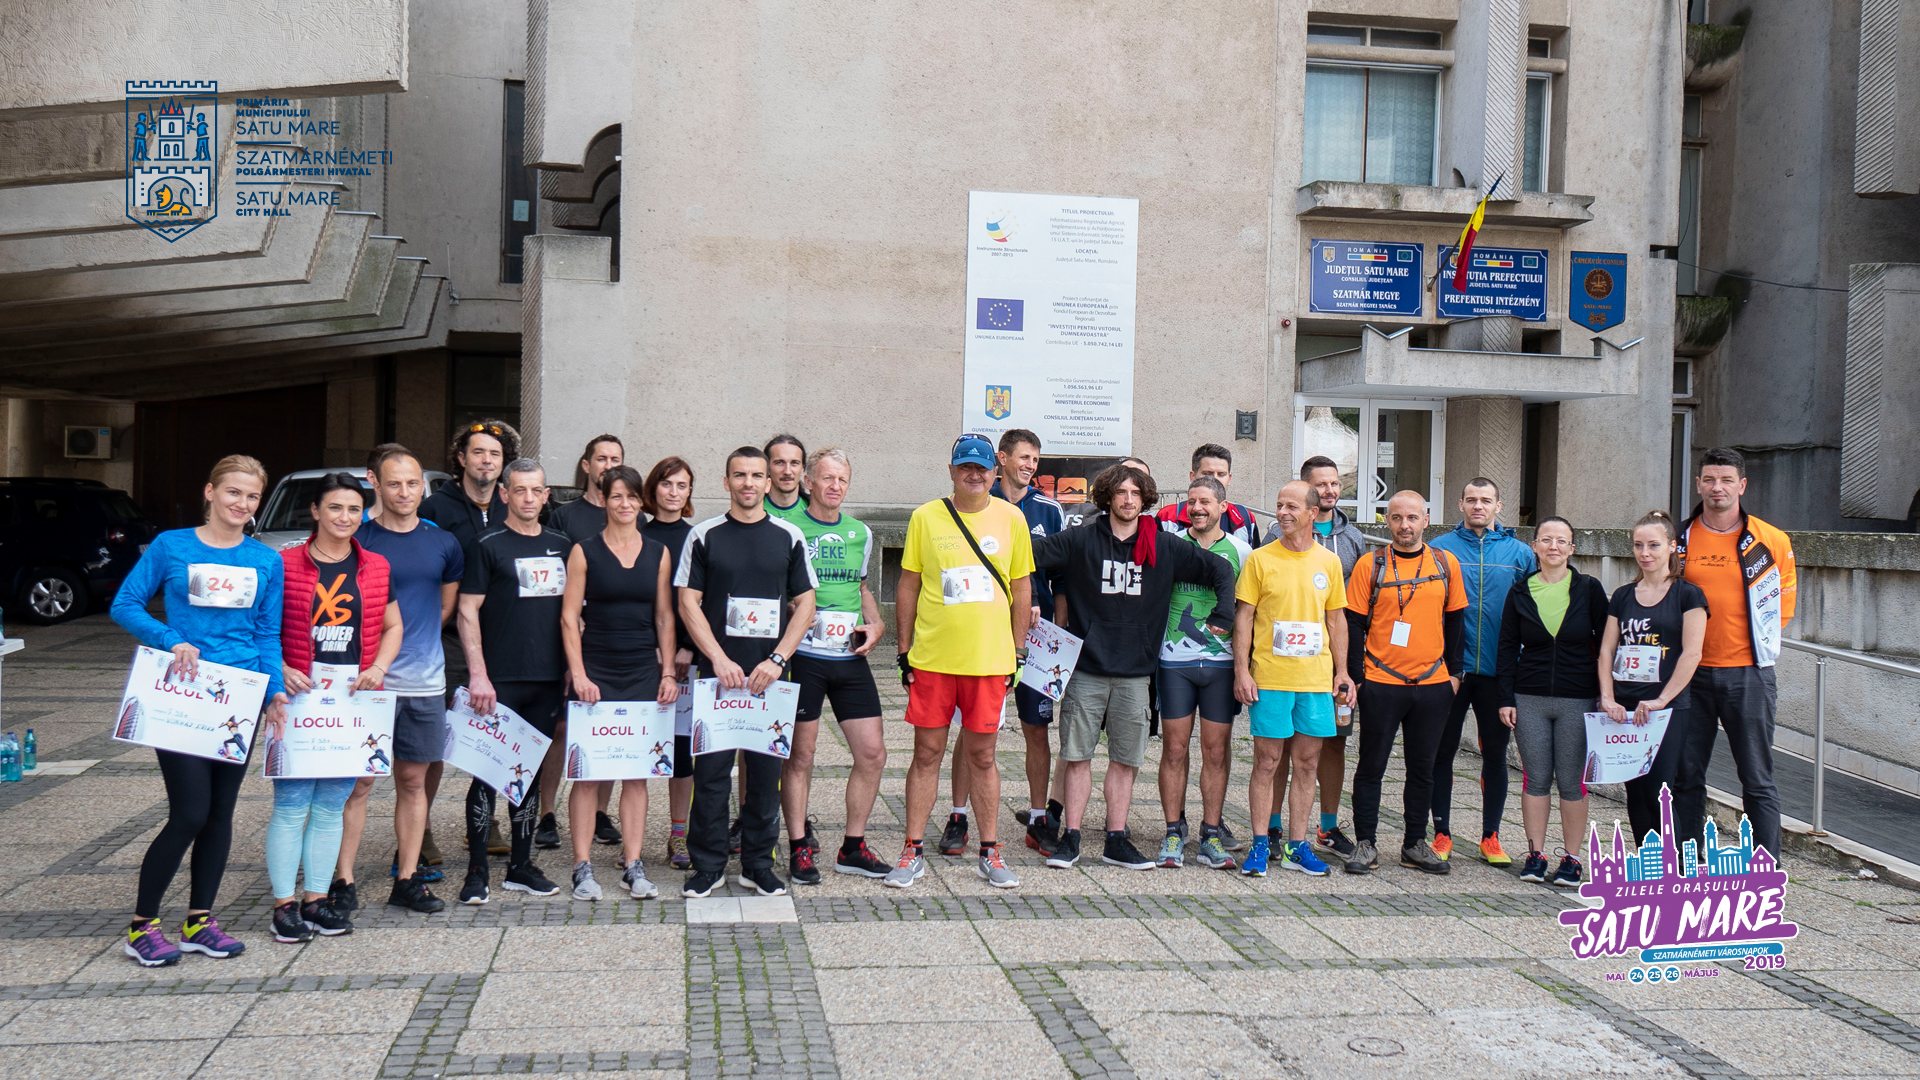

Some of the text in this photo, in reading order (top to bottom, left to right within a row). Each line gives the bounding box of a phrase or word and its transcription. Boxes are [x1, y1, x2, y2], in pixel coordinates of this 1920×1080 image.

[1364, 266, 1385, 276] SATU
[1386, 267, 1409, 277] MARE
[1489, 272, 1543, 284] PREFECTULUI
[1332, 287, 1401, 301] SZATMÁR MEGYE
[1444, 294, 1541, 307] PREFEKTUSI INTÉZMÉNY
[1241, 415, 1253, 435] B
[821, 546, 845, 559] EKE
[533, 570, 549, 583] 17
[208, 577, 235, 592] 24
[962, 578, 970, 590] 1
[747, 611, 758, 624] 4
[826, 623, 846, 636] 20
[1621, 617, 1652, 635] LIVE
[312, 625, 355, 642] POWER
[1287, 633, 1307, 645] 22
[1623, 631, 1661, 646] IN THE
[321, 640, 349, 652] DRINK
[1626, 657, 1640, 669] 13
[320, 678, 334, 690] 7
[713, 699, 755, 711] LOCUL
[294, 717, 344, 728] LOCUL
[592, 726, 635, 736] LOCUL
[1605, 734, 1639, 744] LOCUL
